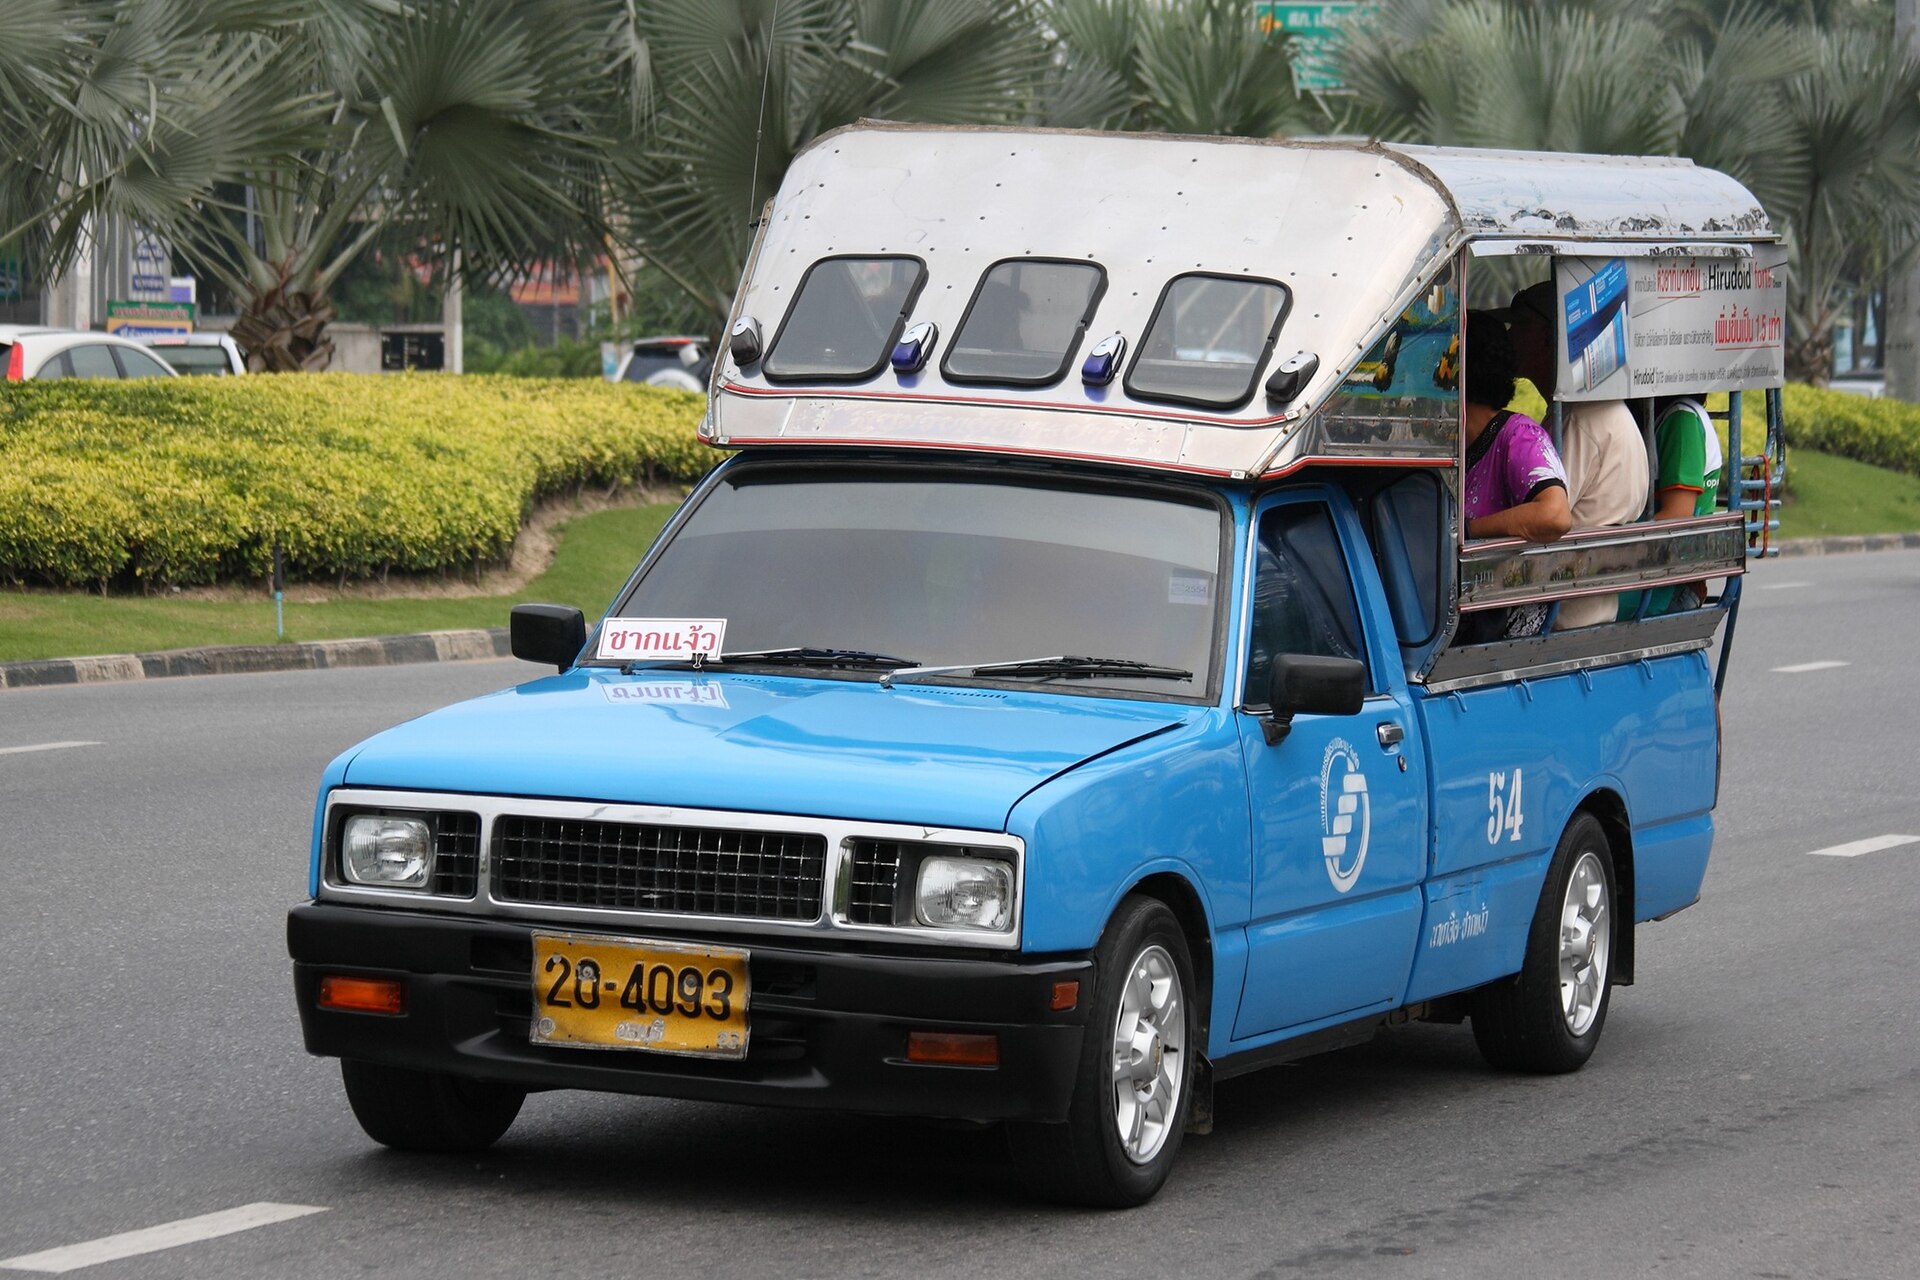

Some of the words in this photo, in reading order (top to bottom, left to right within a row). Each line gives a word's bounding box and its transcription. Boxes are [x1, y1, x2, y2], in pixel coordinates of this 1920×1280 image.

[1708, 263, 1751, 291] Hirudoid
[1715, 304, 1753, 343] เพิ่มขึ้นเป็น
[1755, 314, 1766, 342] 1.5
[1768, 309, 1781, 341] เท่า
[1633, 367, 1655, 385] Hirudoid
[610, 625, 716, 650] ชากแง้ว
[1487, 767, 1524, 845] 54
[545, 953, 733, 1021] 20-4093
